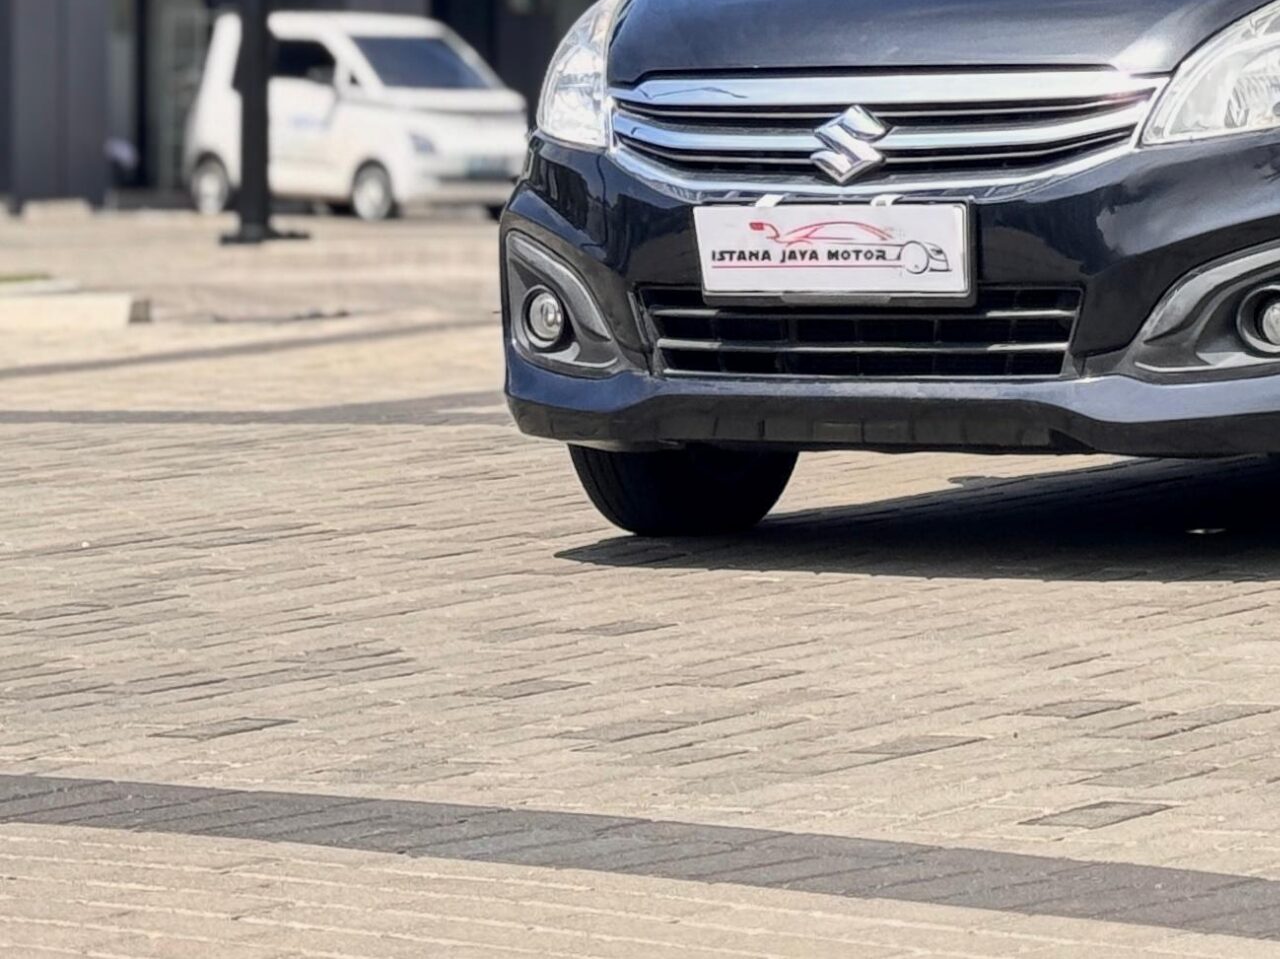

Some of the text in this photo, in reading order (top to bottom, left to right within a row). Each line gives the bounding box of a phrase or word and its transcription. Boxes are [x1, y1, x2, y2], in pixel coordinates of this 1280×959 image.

[711, 249, 887, 264] ISTANA JAYA MOTOR
